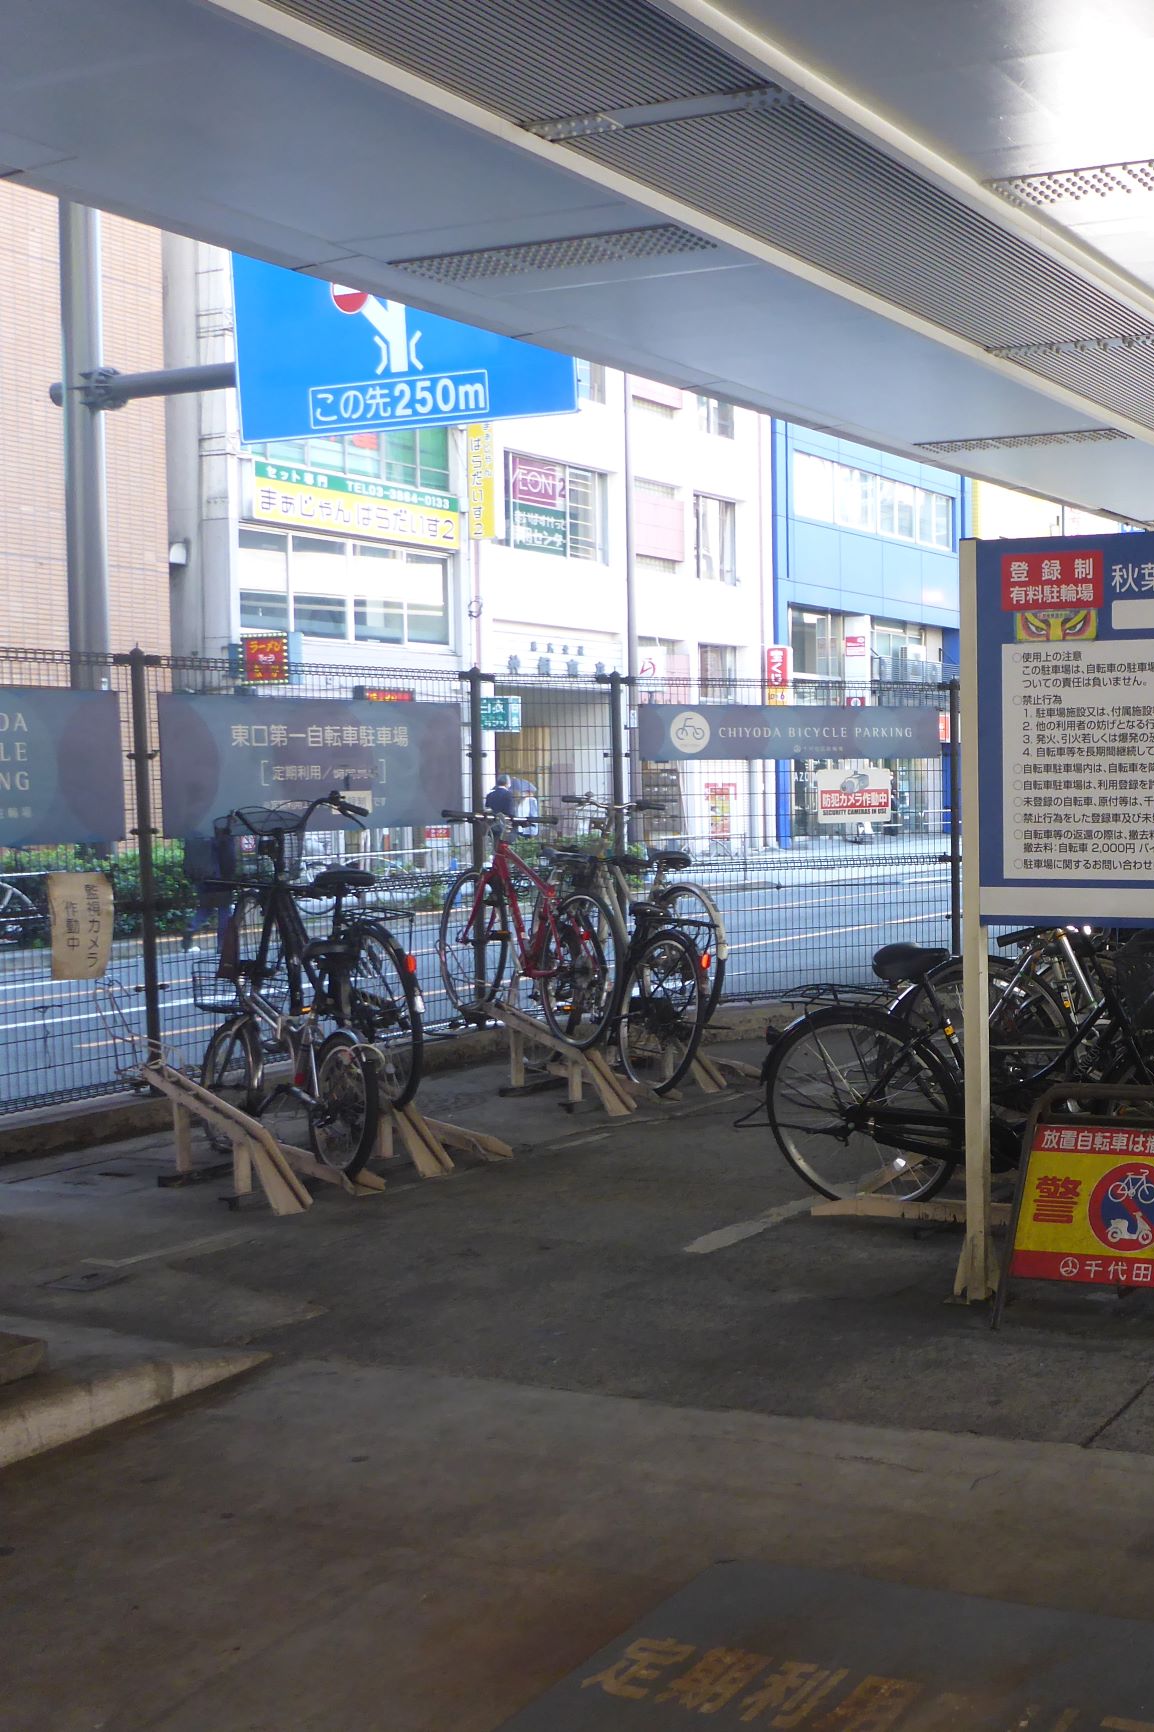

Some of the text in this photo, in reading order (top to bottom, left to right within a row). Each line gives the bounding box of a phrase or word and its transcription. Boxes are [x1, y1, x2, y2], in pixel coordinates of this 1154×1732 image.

[315, 378, 486, 422] この先250m
[1010, 583, 1094, 605] 有料駐輪場
[1022, 676, 1148, 689] ついての責任は負いません。
[230, 724, 410, 748] 東口第一自転車駐車場
[719, 727, 913, 738] CHIYODA BICYCLE PARKING
[822, 792, 888, 808] 防犯カメラ作動中
[847, 808, 871, 816] CAMERAS
[64, 901, 81, 951] 作動中
